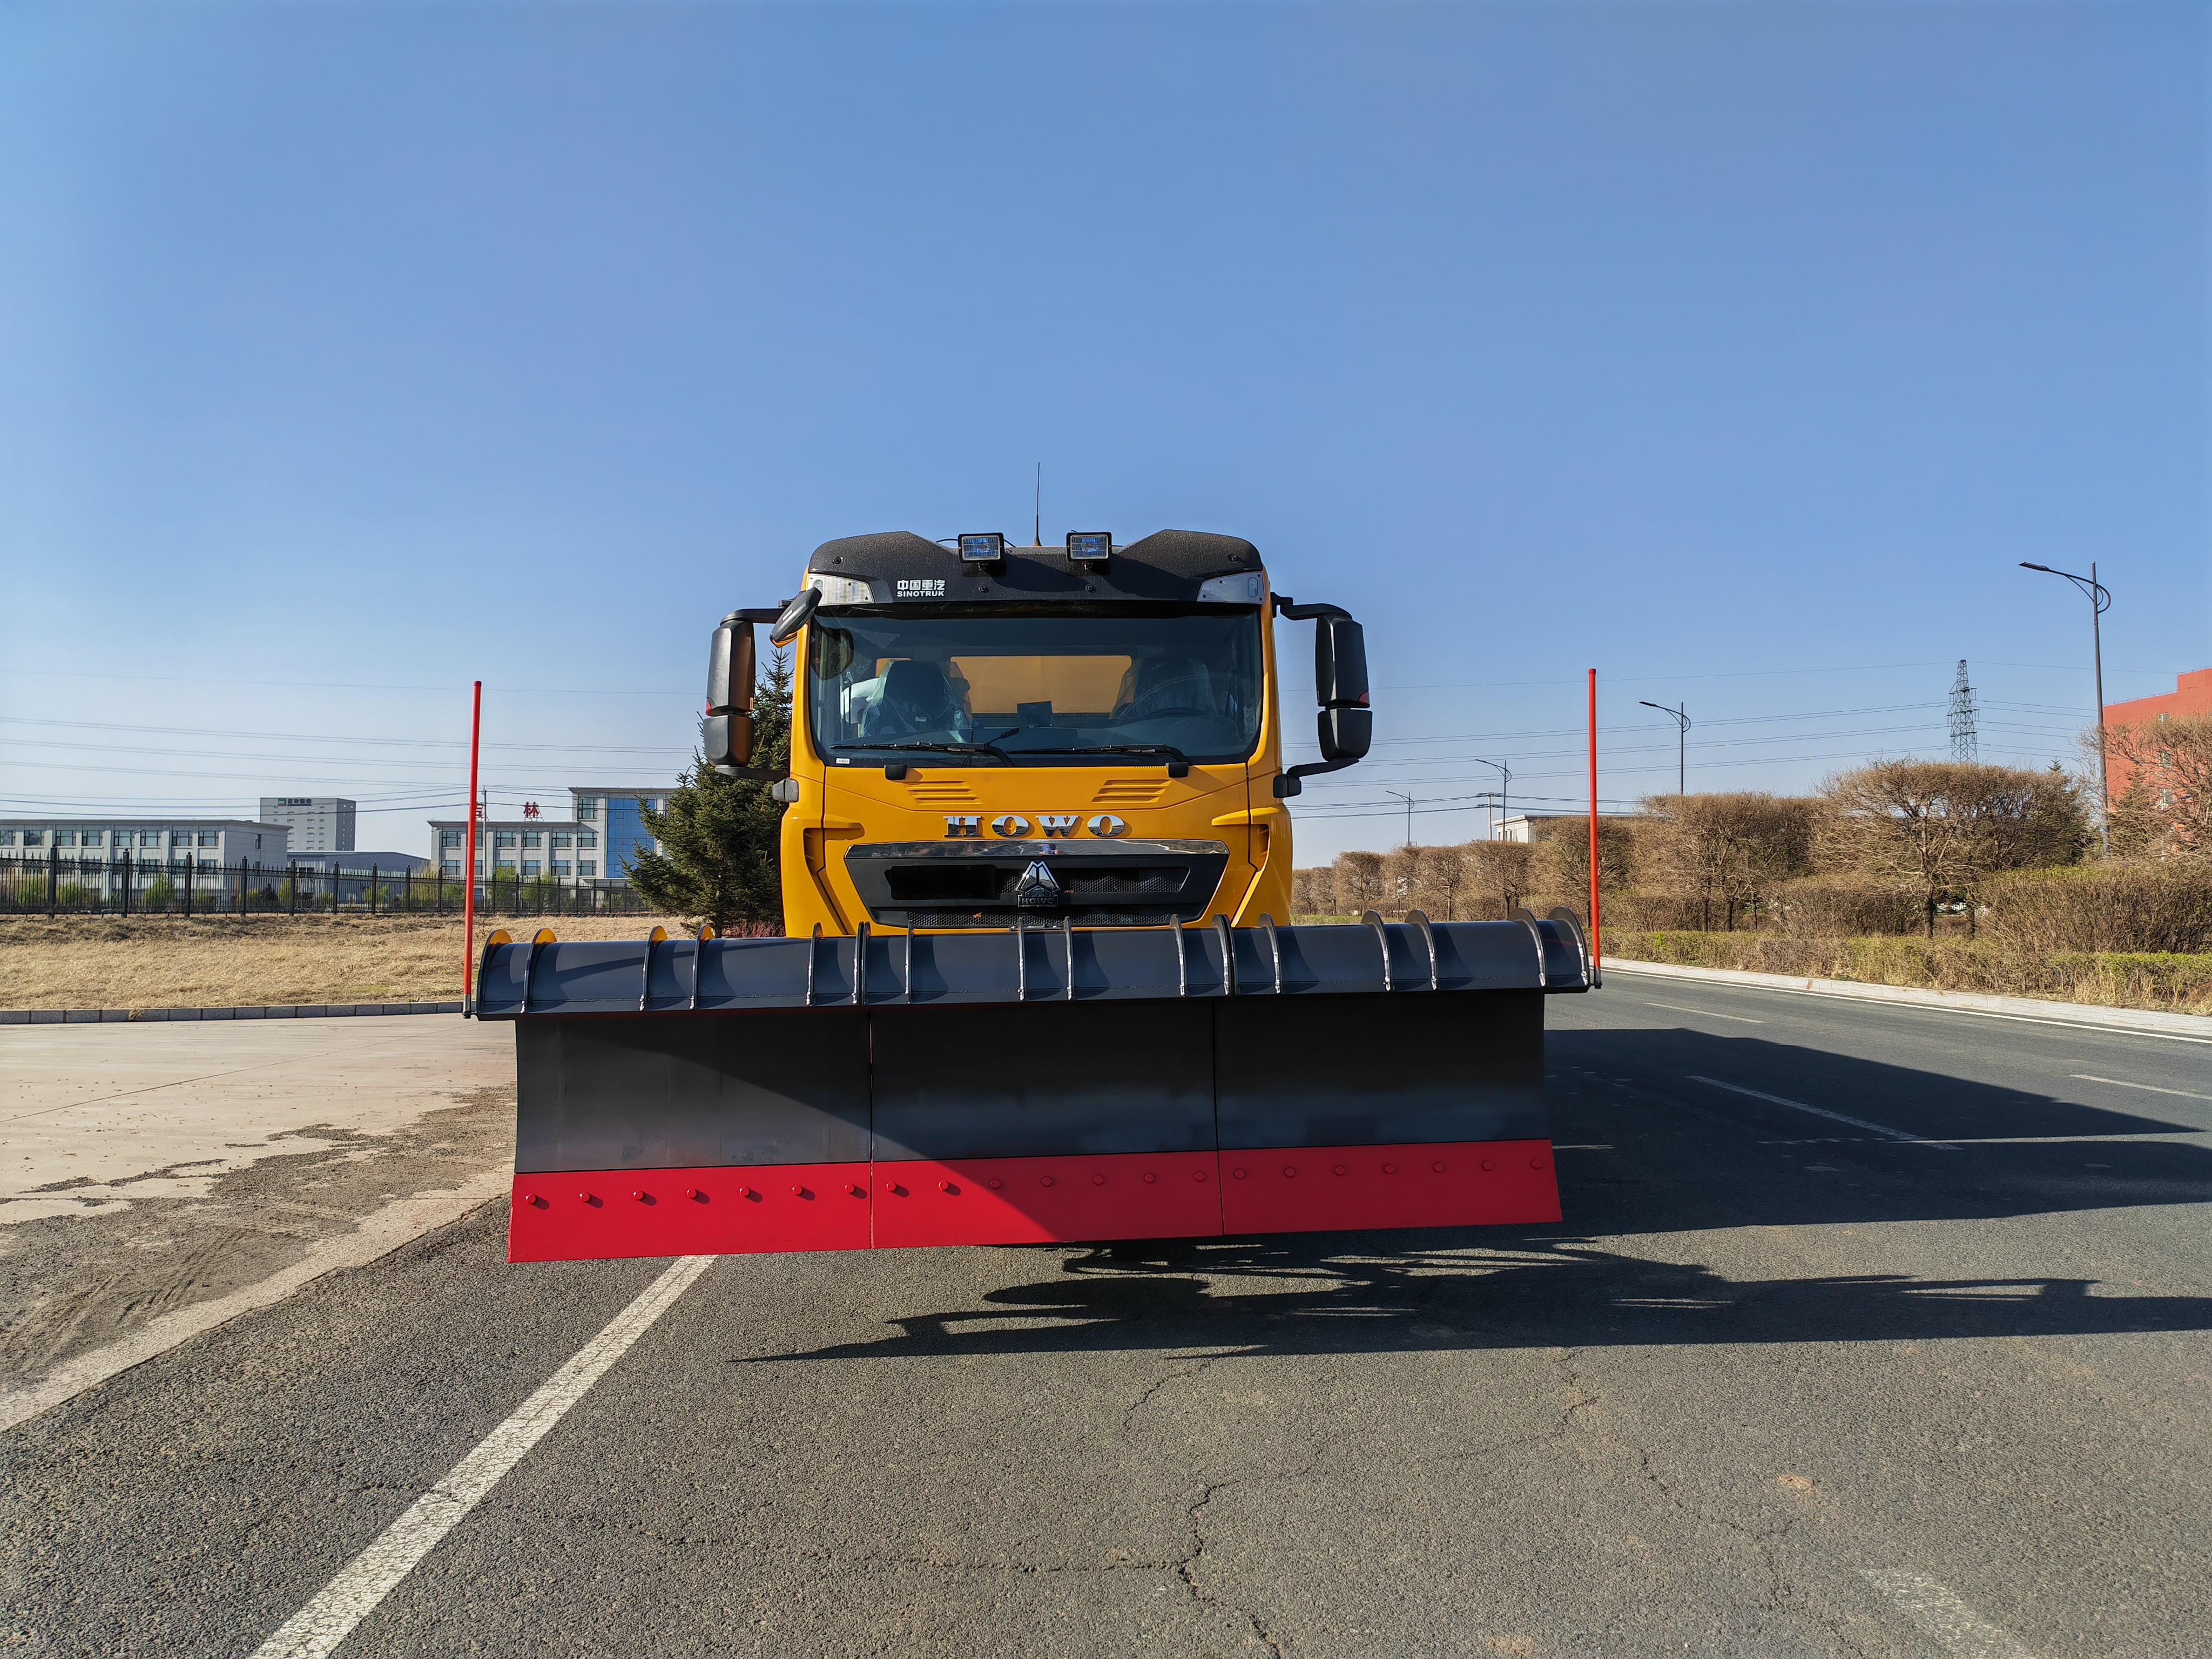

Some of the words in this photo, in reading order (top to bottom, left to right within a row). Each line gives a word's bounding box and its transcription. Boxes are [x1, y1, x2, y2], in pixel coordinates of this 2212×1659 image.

[897, 579, 945, 590] 中国重汽
[943, 814, 1125, 838] HOWO
